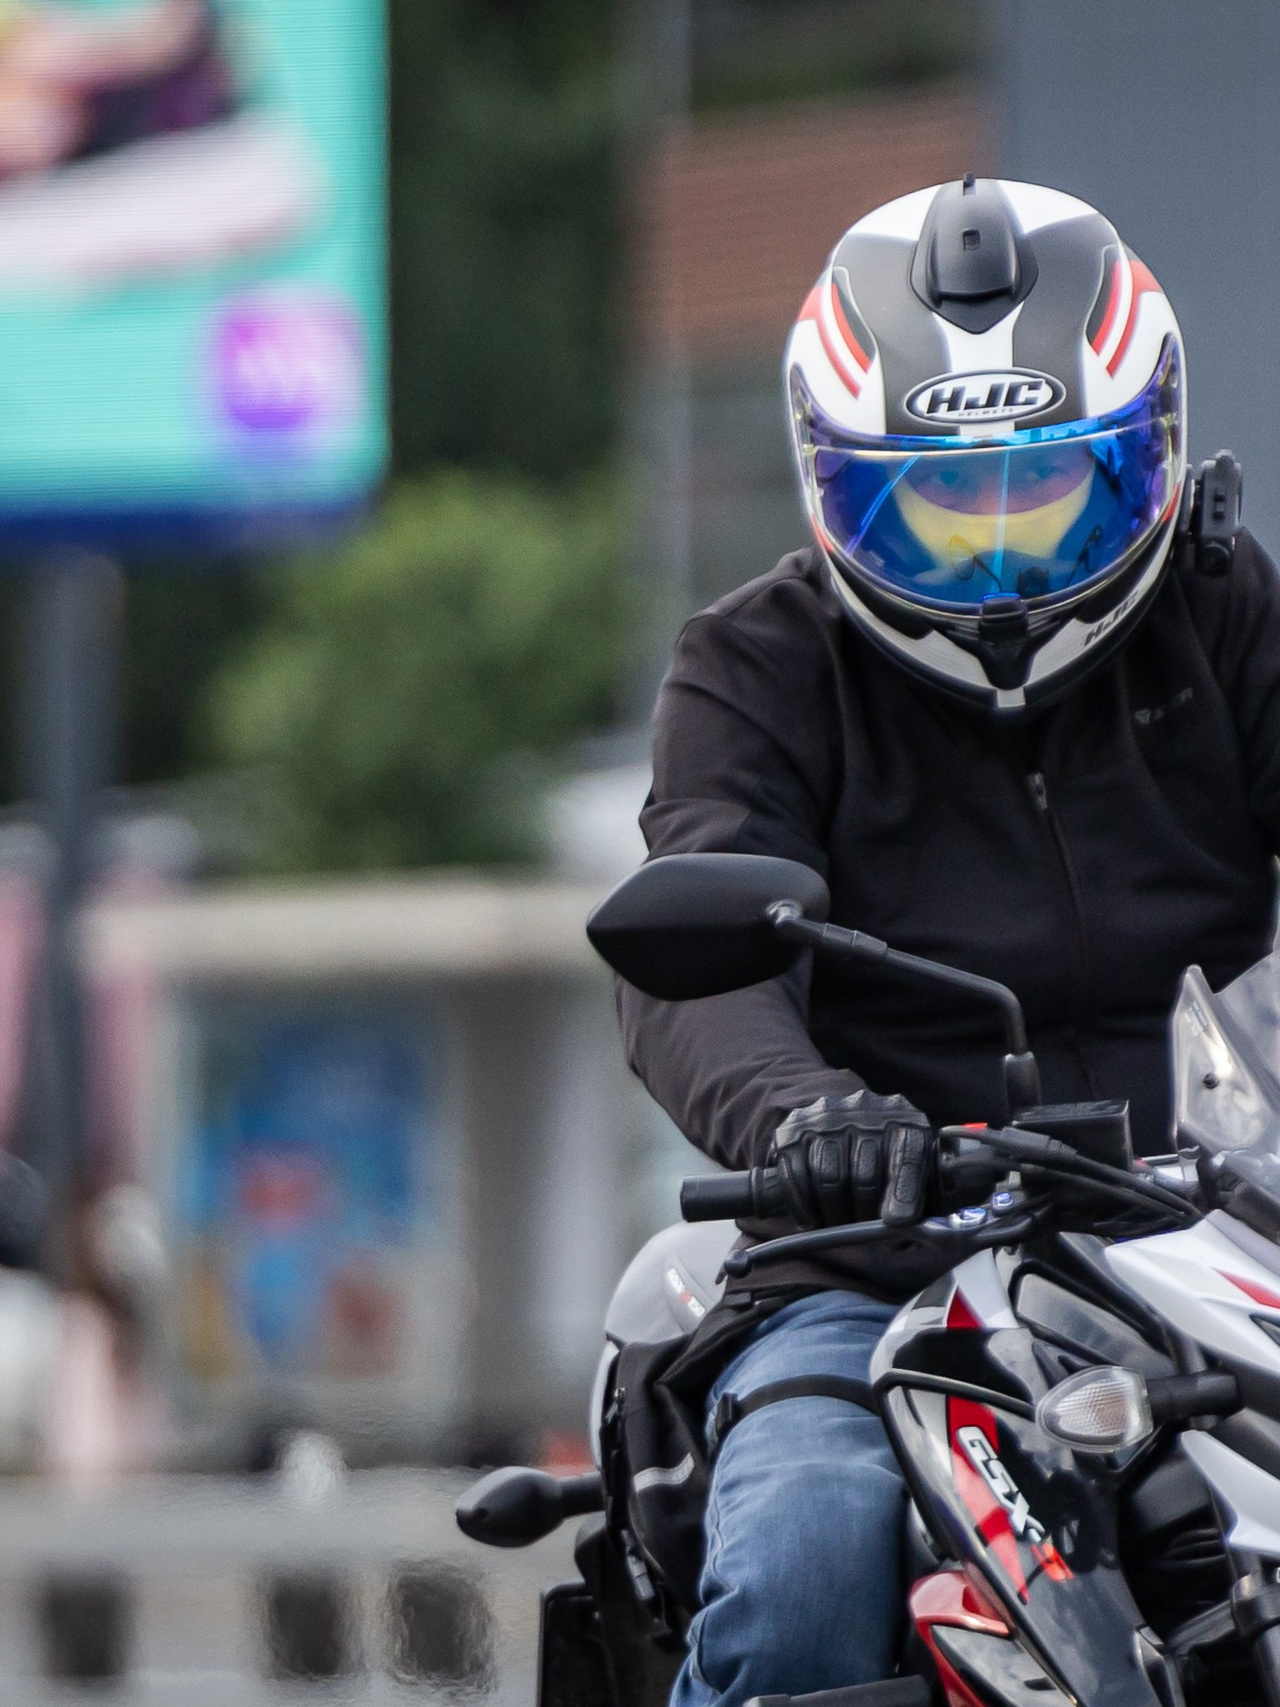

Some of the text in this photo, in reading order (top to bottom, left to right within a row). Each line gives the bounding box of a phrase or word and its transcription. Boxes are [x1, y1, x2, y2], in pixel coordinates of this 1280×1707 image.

[926, 380, 1043, 415] HJC
[958, 407, 1014, 418] HELMETS
[1084, 589, 1139, 647] HJC
